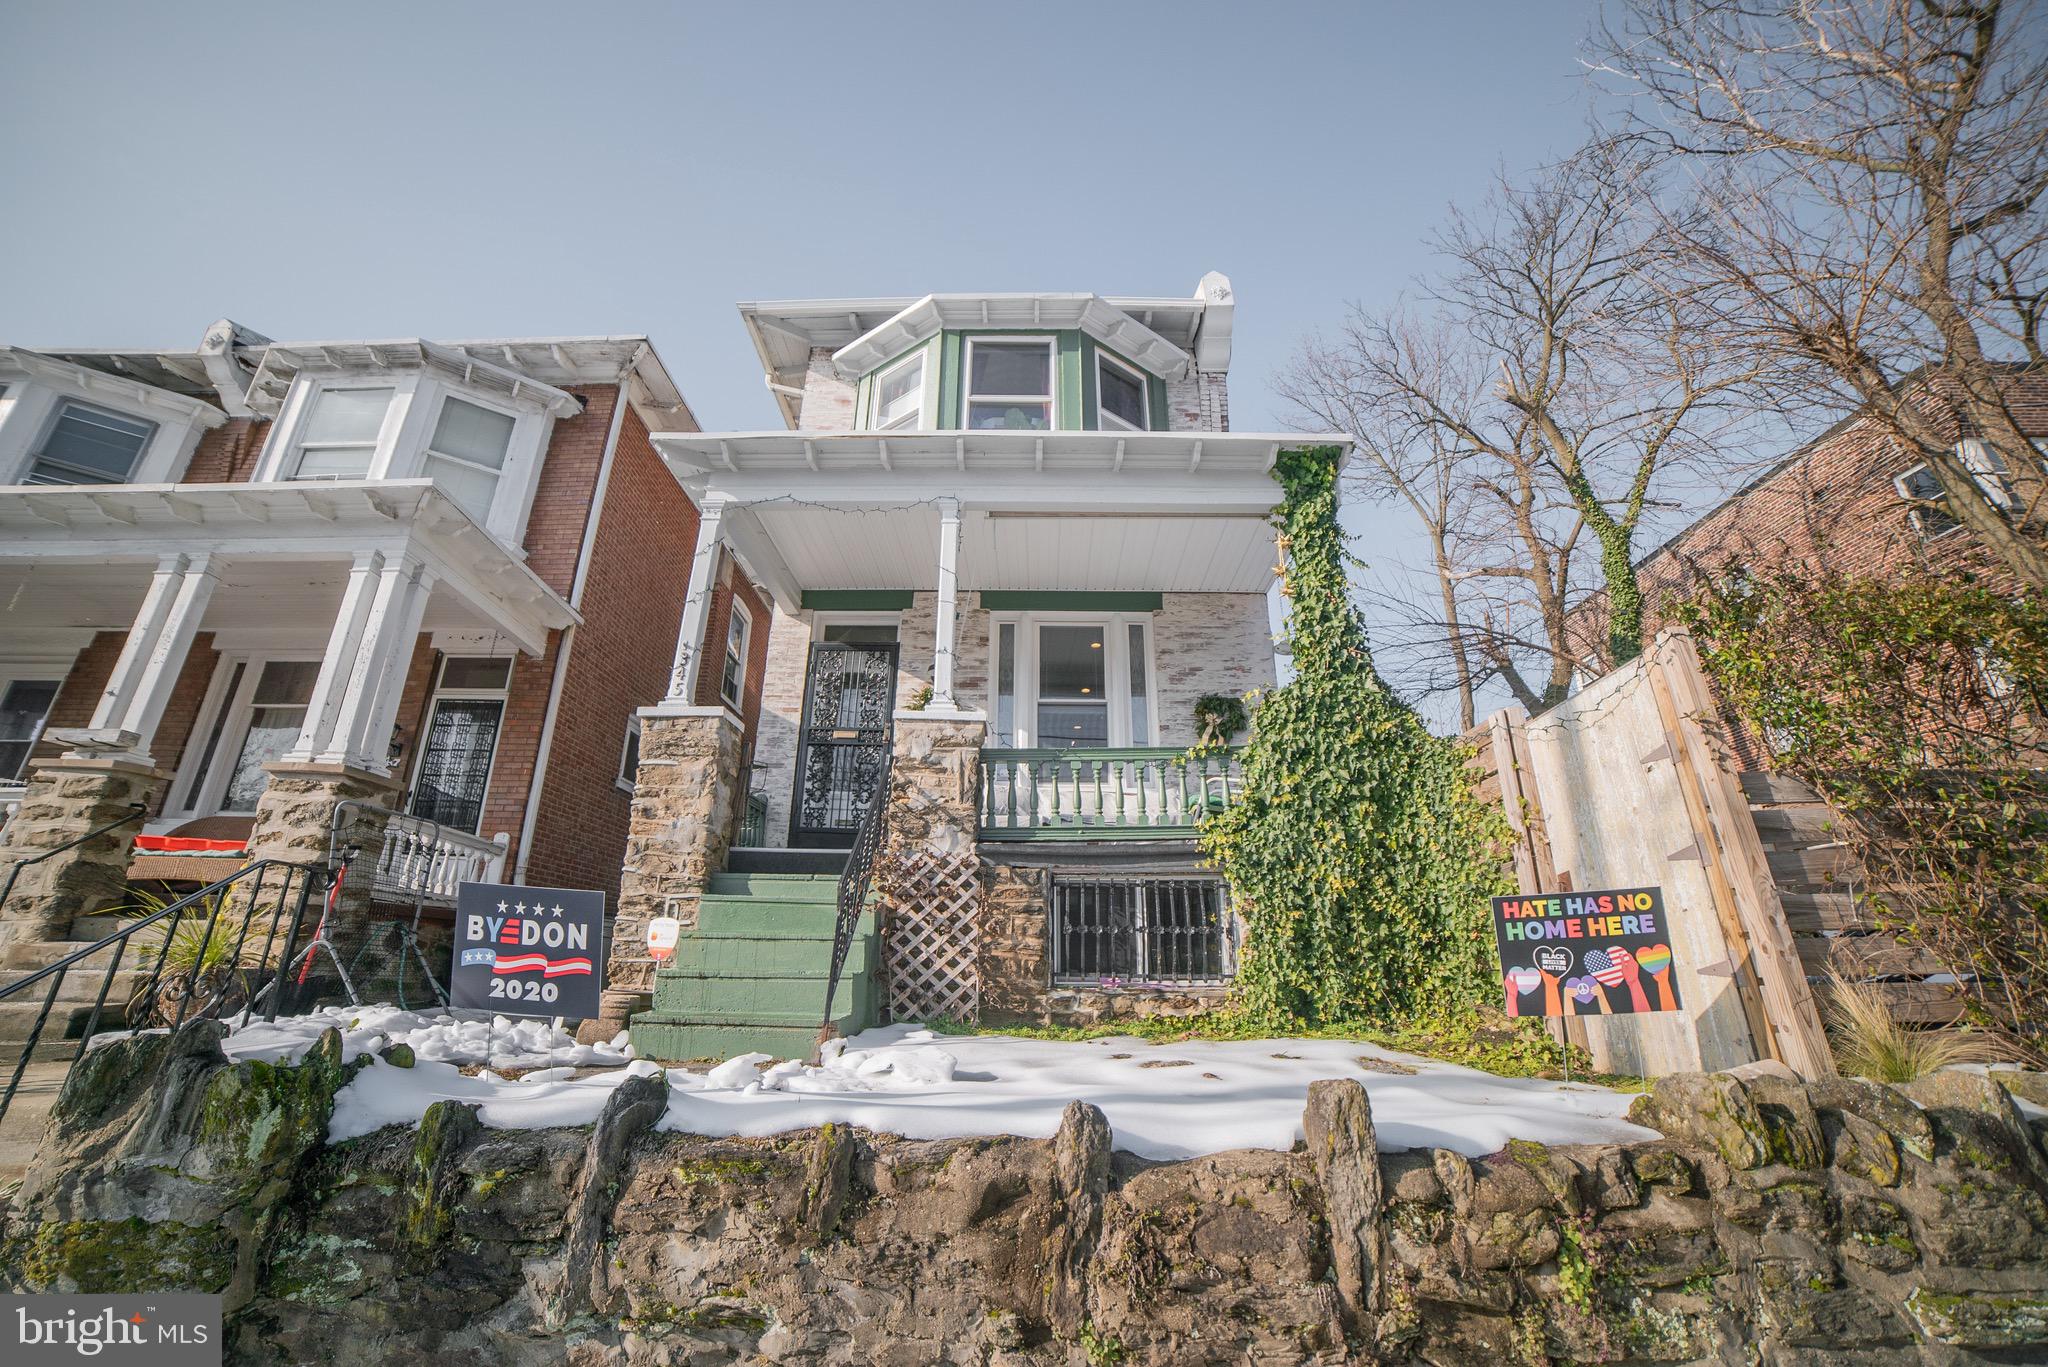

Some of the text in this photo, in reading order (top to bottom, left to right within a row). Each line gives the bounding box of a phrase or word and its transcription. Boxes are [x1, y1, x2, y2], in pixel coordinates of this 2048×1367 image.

[1502, 892, 1653, 919] HATE HAS NO
[466, 914, 588, 950] BYEDON
[1505, 914, 1656, 941] HOME HERE
[1541, 952, 1566, 960] BLACK
[488, 977, 559, 1003] 2020
